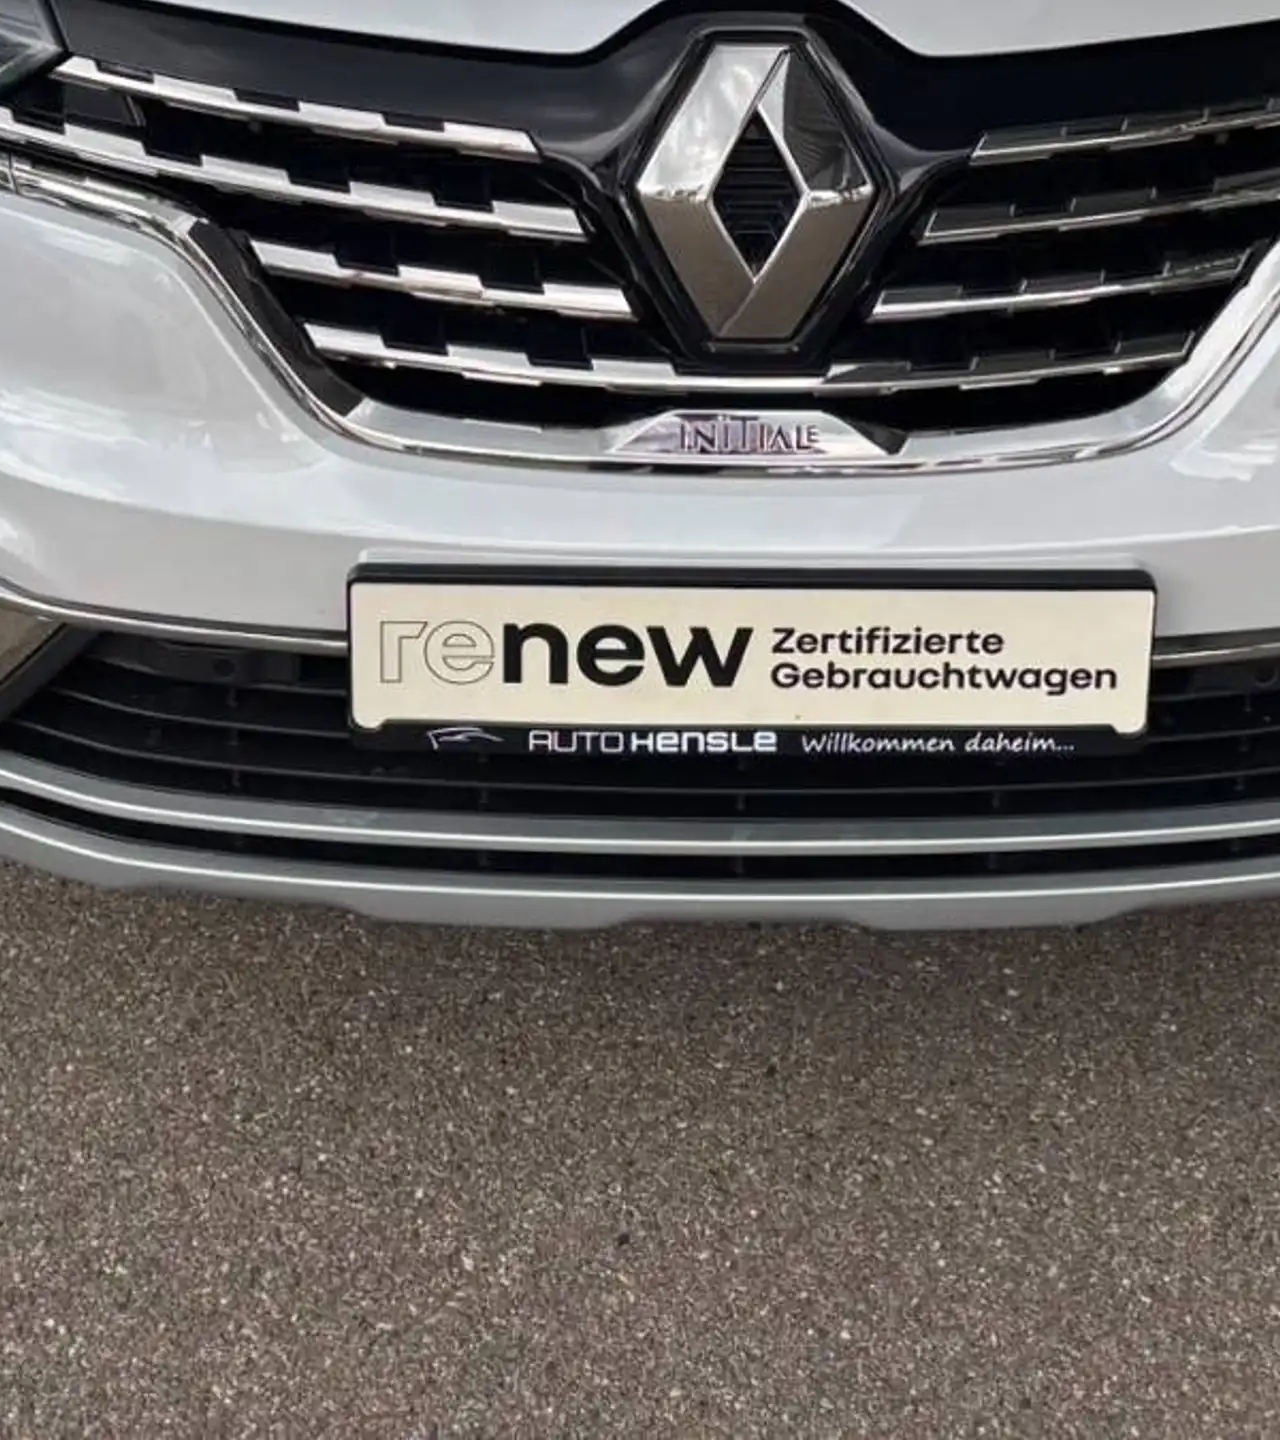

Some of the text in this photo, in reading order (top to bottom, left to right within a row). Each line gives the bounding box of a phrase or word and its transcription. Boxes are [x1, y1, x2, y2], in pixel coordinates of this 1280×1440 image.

[380, 620, 754, 688] renew
[772, 626, 1005, 655] Zertifizierte
[771, 661, 1118, 697] Gebrauchtwagen
[801, 731, 955, 753] Willkommen
